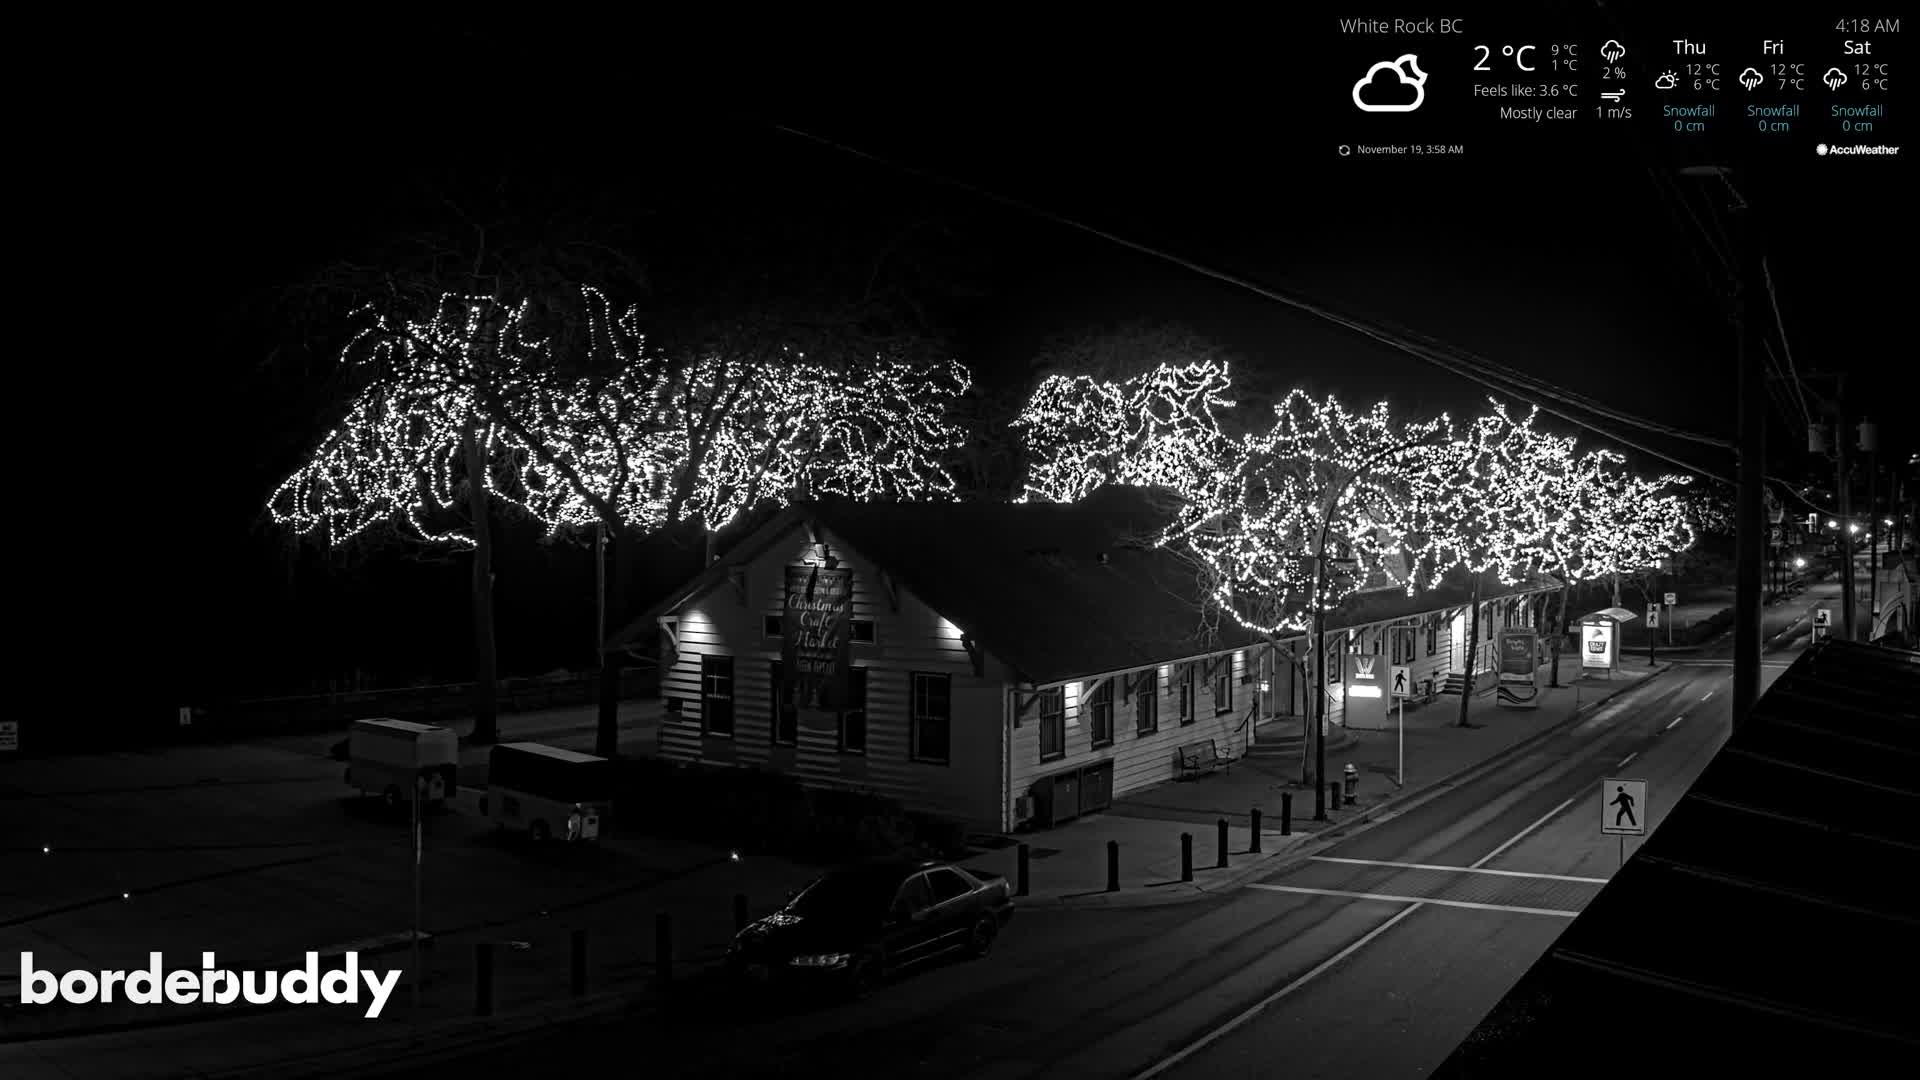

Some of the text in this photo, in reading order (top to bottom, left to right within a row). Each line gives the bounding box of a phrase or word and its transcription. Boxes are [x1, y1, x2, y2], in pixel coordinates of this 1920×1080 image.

[788, 593, 845, 613] Christmas
[800, 610, 832, 637] Craft
[794, 630, 839, 649] Market
